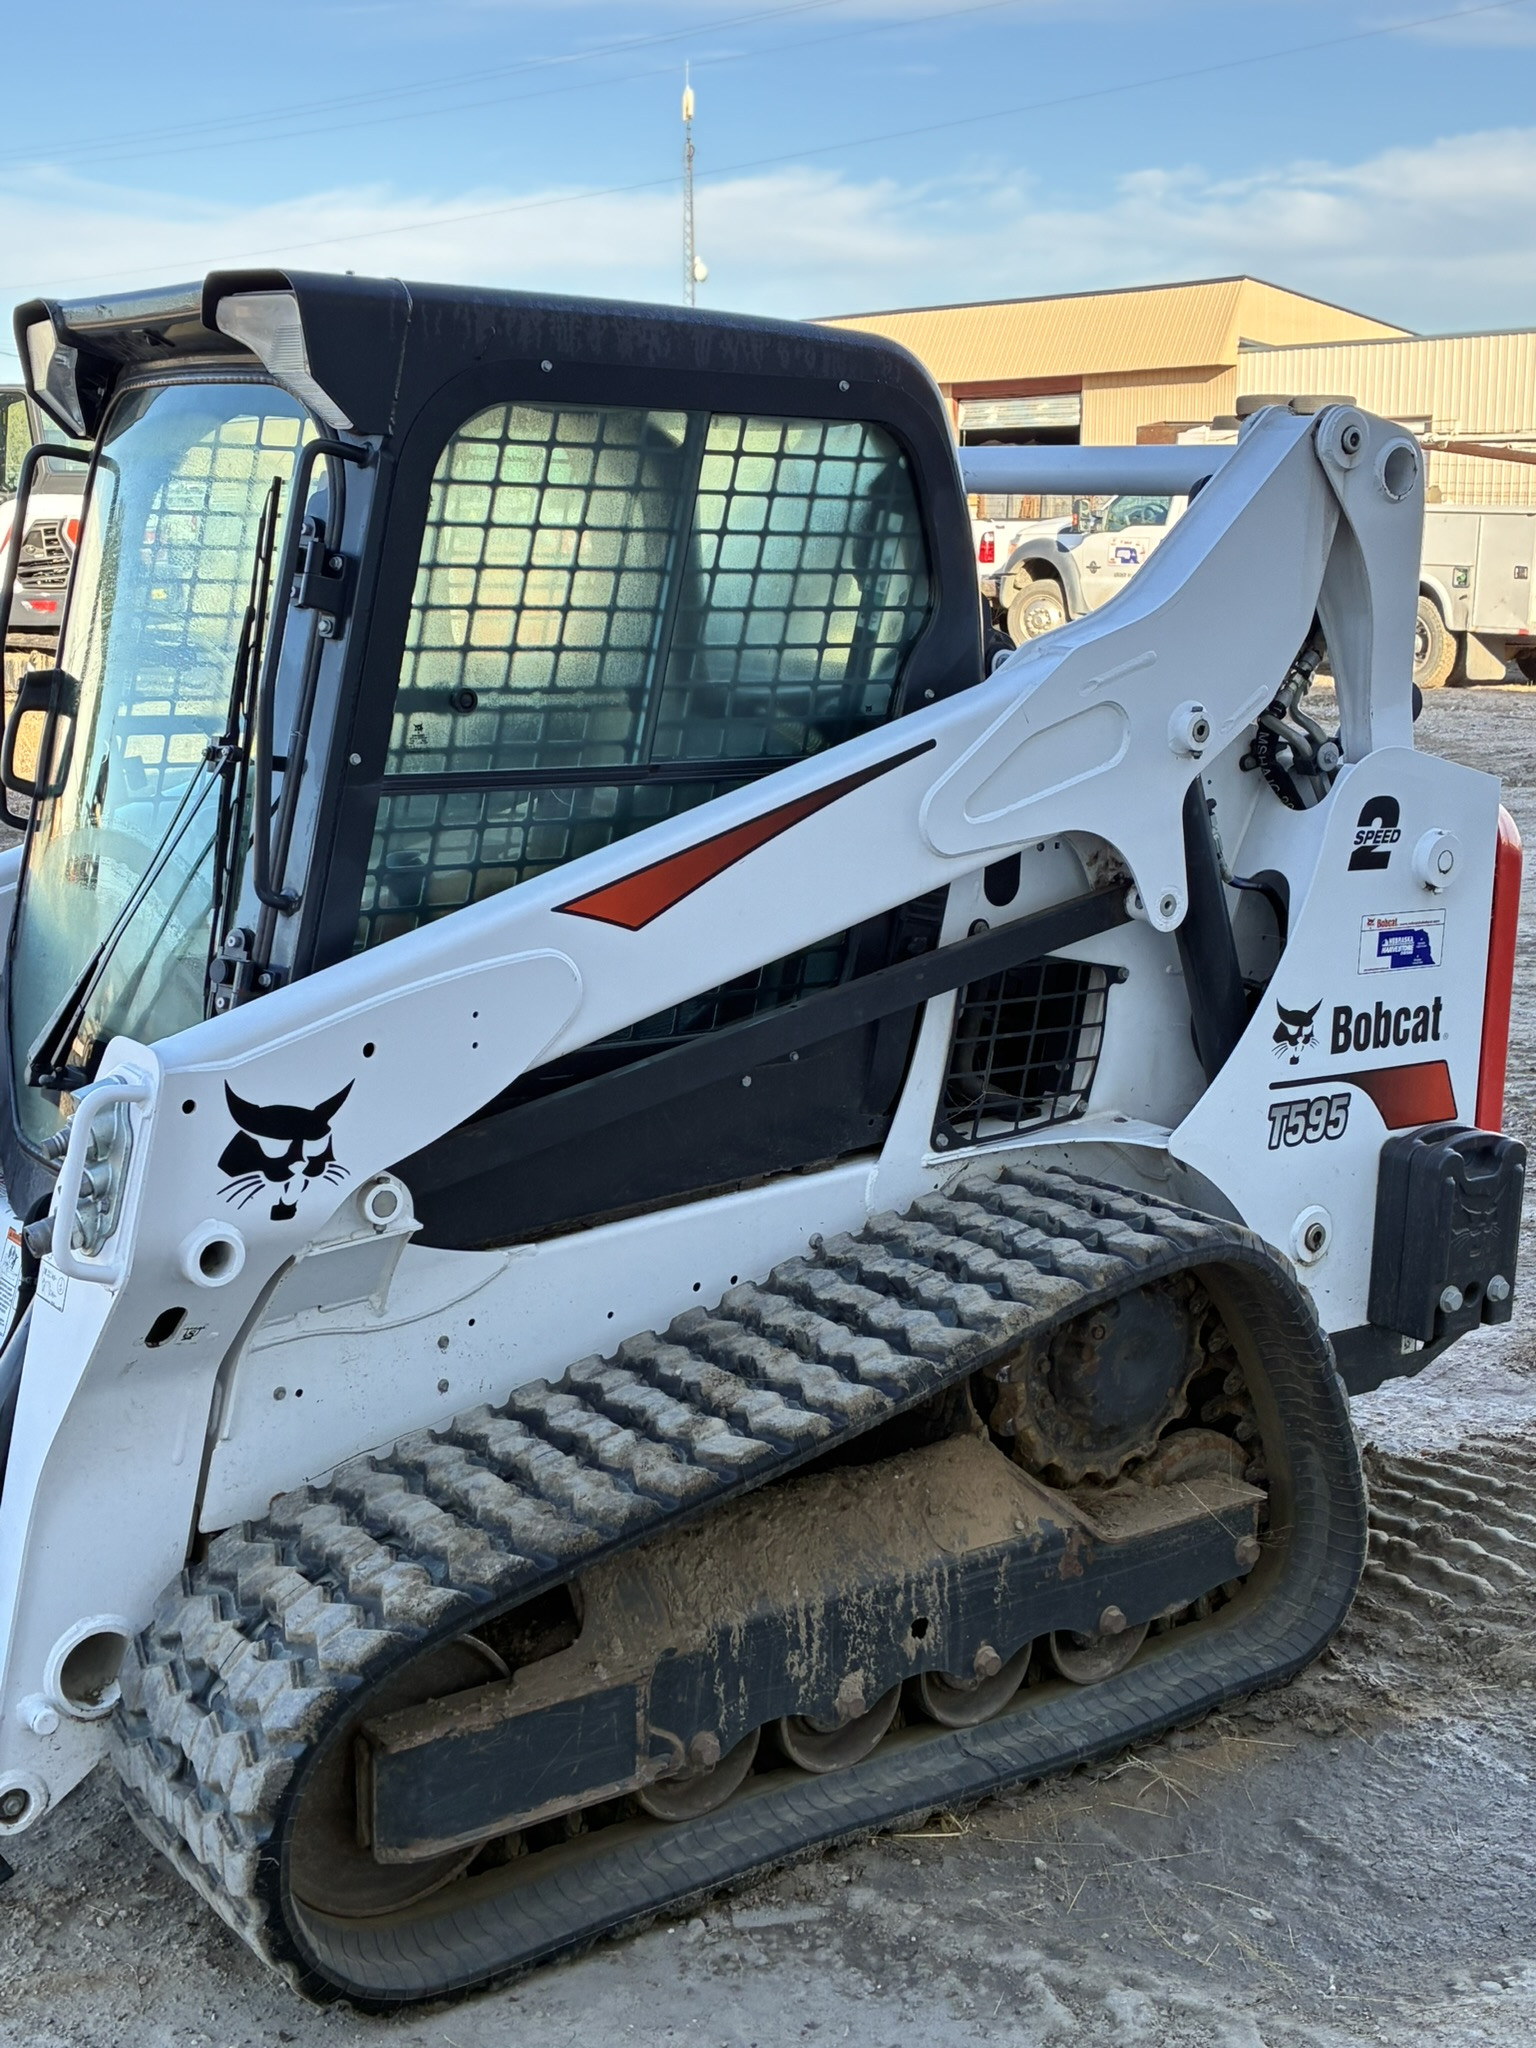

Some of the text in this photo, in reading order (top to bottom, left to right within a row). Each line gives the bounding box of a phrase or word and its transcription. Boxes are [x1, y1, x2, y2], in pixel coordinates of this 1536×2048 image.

[1347, 795, 1400, 871] 2
[1353, 828, 1402, 846] SPEED
[1376, 917, 1398, 928] Bobcat
[1330, 996, 1443, 1055] Bobcat
[1268, 1092, 1351, 1150] T595
